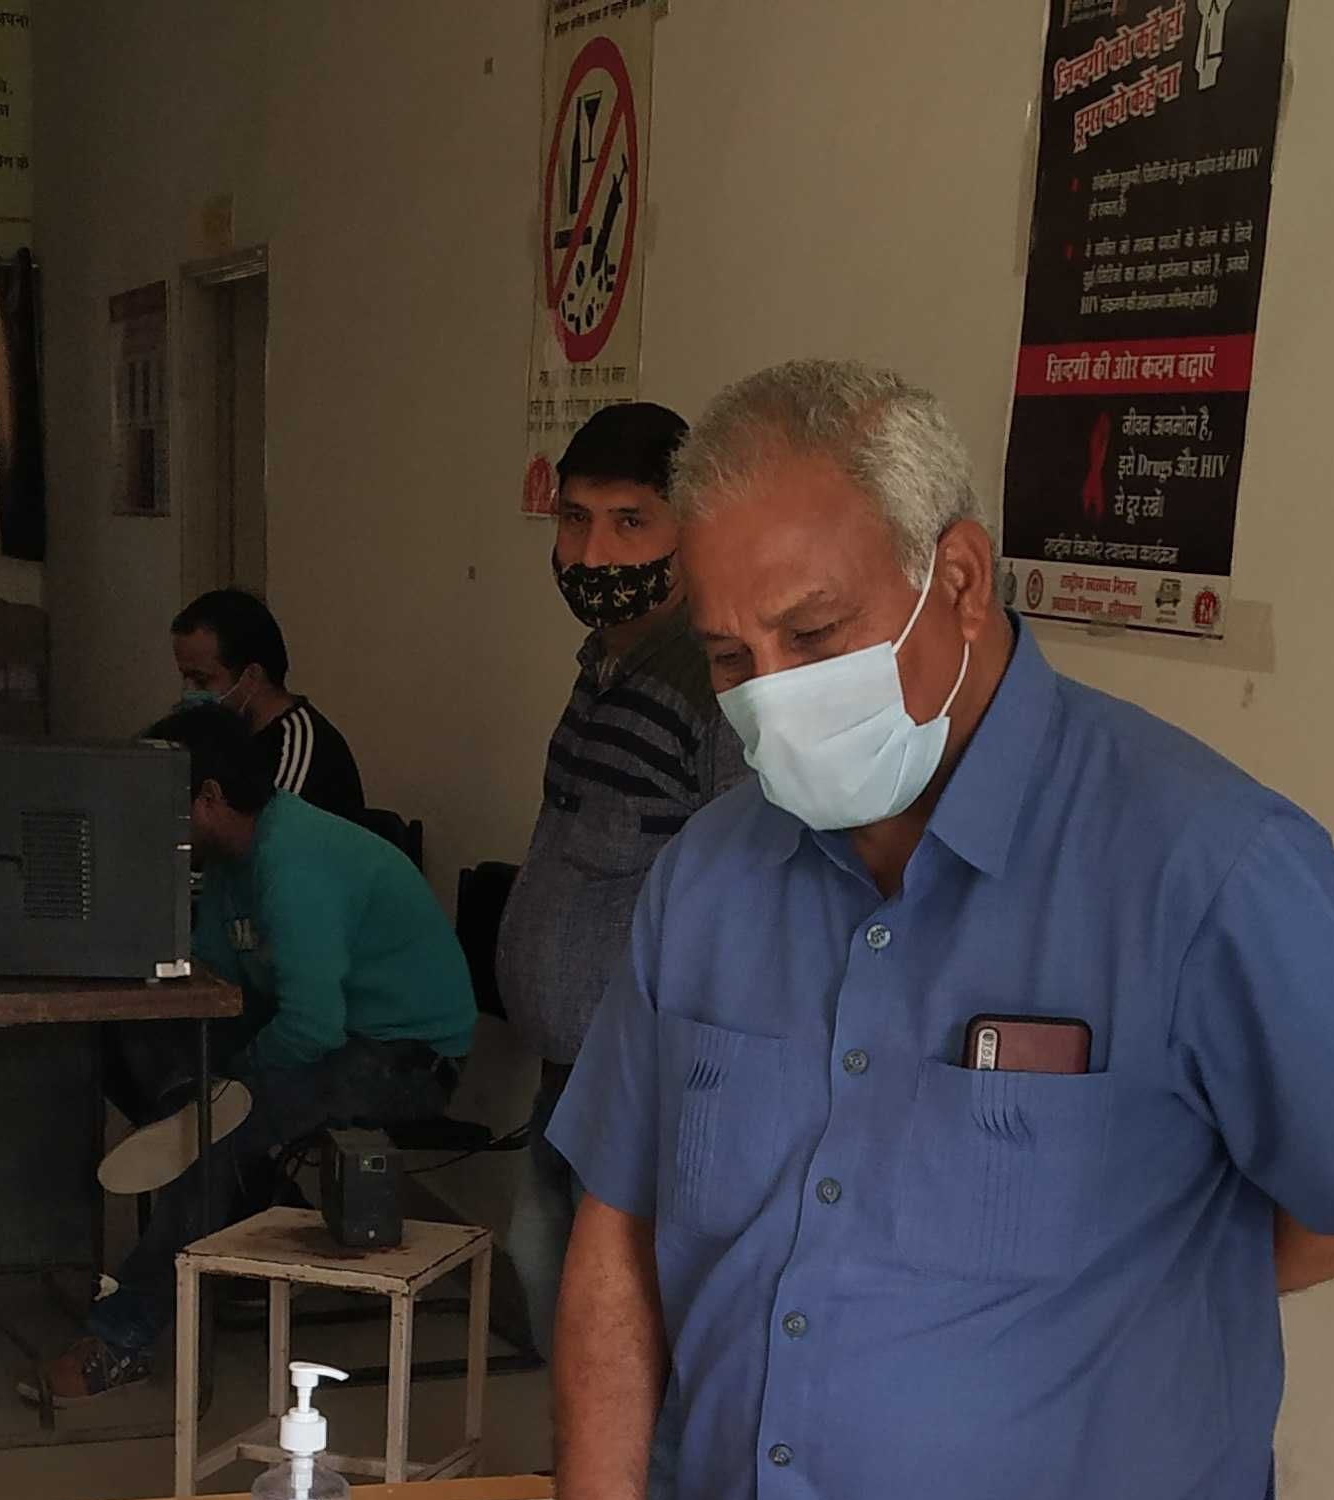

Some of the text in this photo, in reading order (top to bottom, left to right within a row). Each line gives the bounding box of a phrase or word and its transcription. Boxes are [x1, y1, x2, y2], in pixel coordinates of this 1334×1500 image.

[1157, 60, 1183, 103] ना
[1237, 147, 1262, 169] HIV
[1091, 350, 1111, 380] की
[1112, 350, 1138, 380] ओर
[1140, 353, 1174, 379] कदम
[1122, 406, 1151, 437] जीवन
[1152, 405, 1198, 437] अनमोल
[1137, 455, 1172, 483] Drugs
[1174, 447, 1198, 478] और
[1199, 454, 1229, 478] HIV
[1126, 495, 1141, 524] दूर
